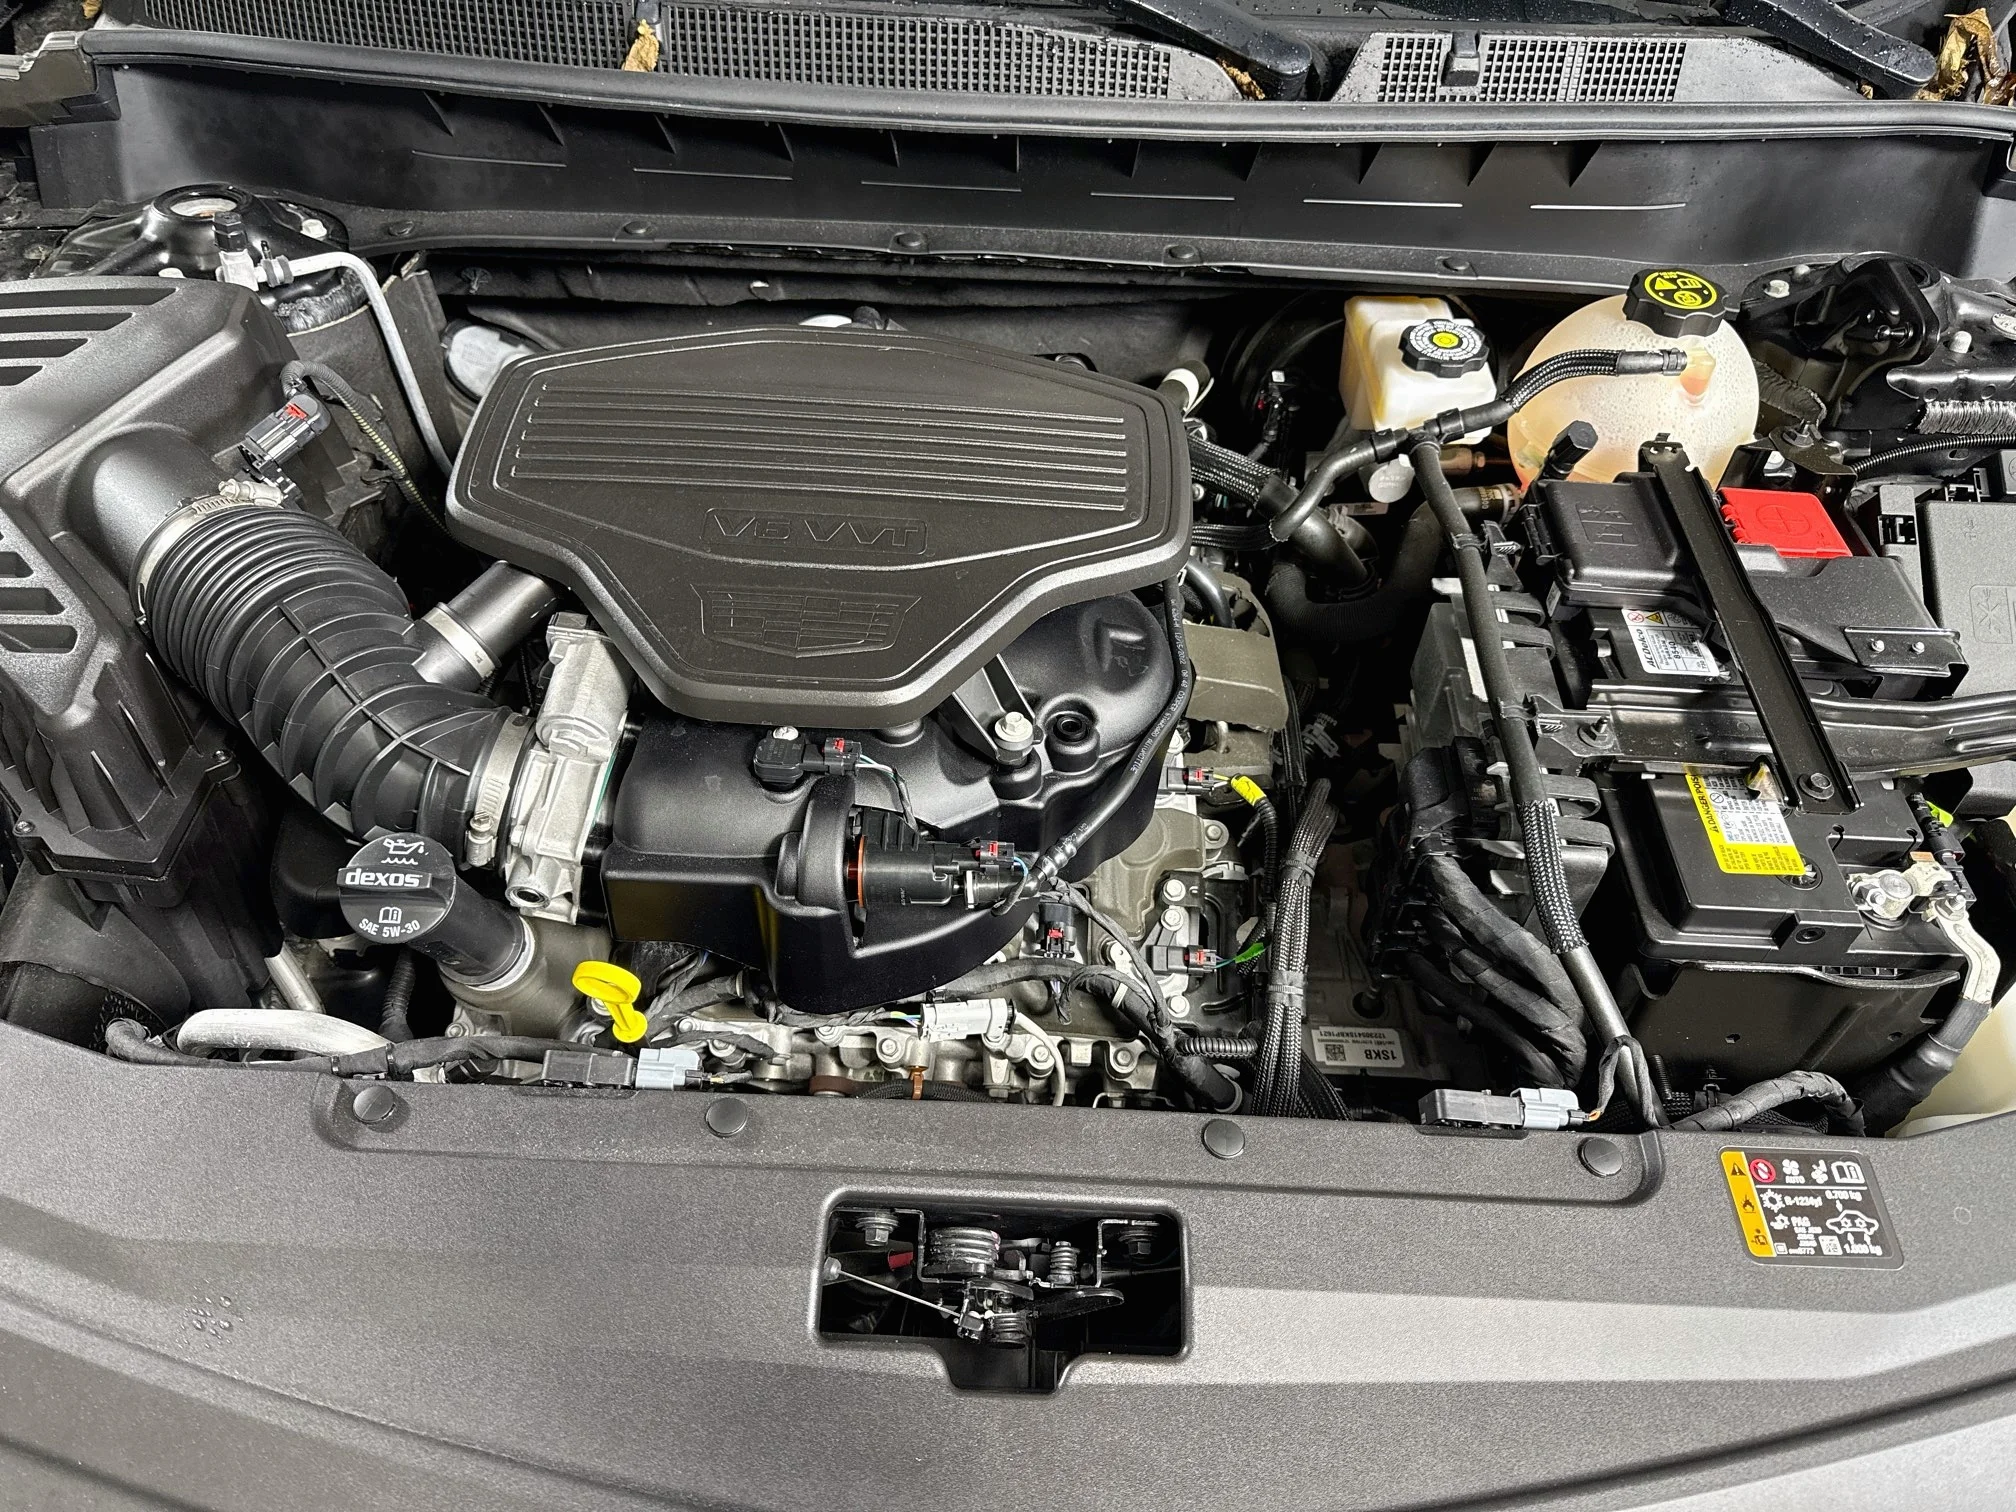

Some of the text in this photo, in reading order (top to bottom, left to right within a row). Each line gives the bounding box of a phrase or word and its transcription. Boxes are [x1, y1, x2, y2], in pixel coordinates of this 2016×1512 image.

[713, 514, 919, 548] V6 VVT
[1636, 628, 1656, 668] ACDelco
[1169, 690, 1186, 712] COOPER
[1130, 738, 1154, 775] AUTOMOTIVE
[345, 868, 423, 887] dexos
[358, 918, 421, 938] SAE 5W-30
[1364, 1049, 1397, 1061] 1SKB
[1785, 1175, 1806, 1184] AUTO
[1784, 1196, 1823, 1208] R-1234yf
[1824, 1190, 1862, 1201] 0.700 kg
[1790, 1216, 1811, 1227] PAG
[1869, 1244, 1883, 1256] kg
